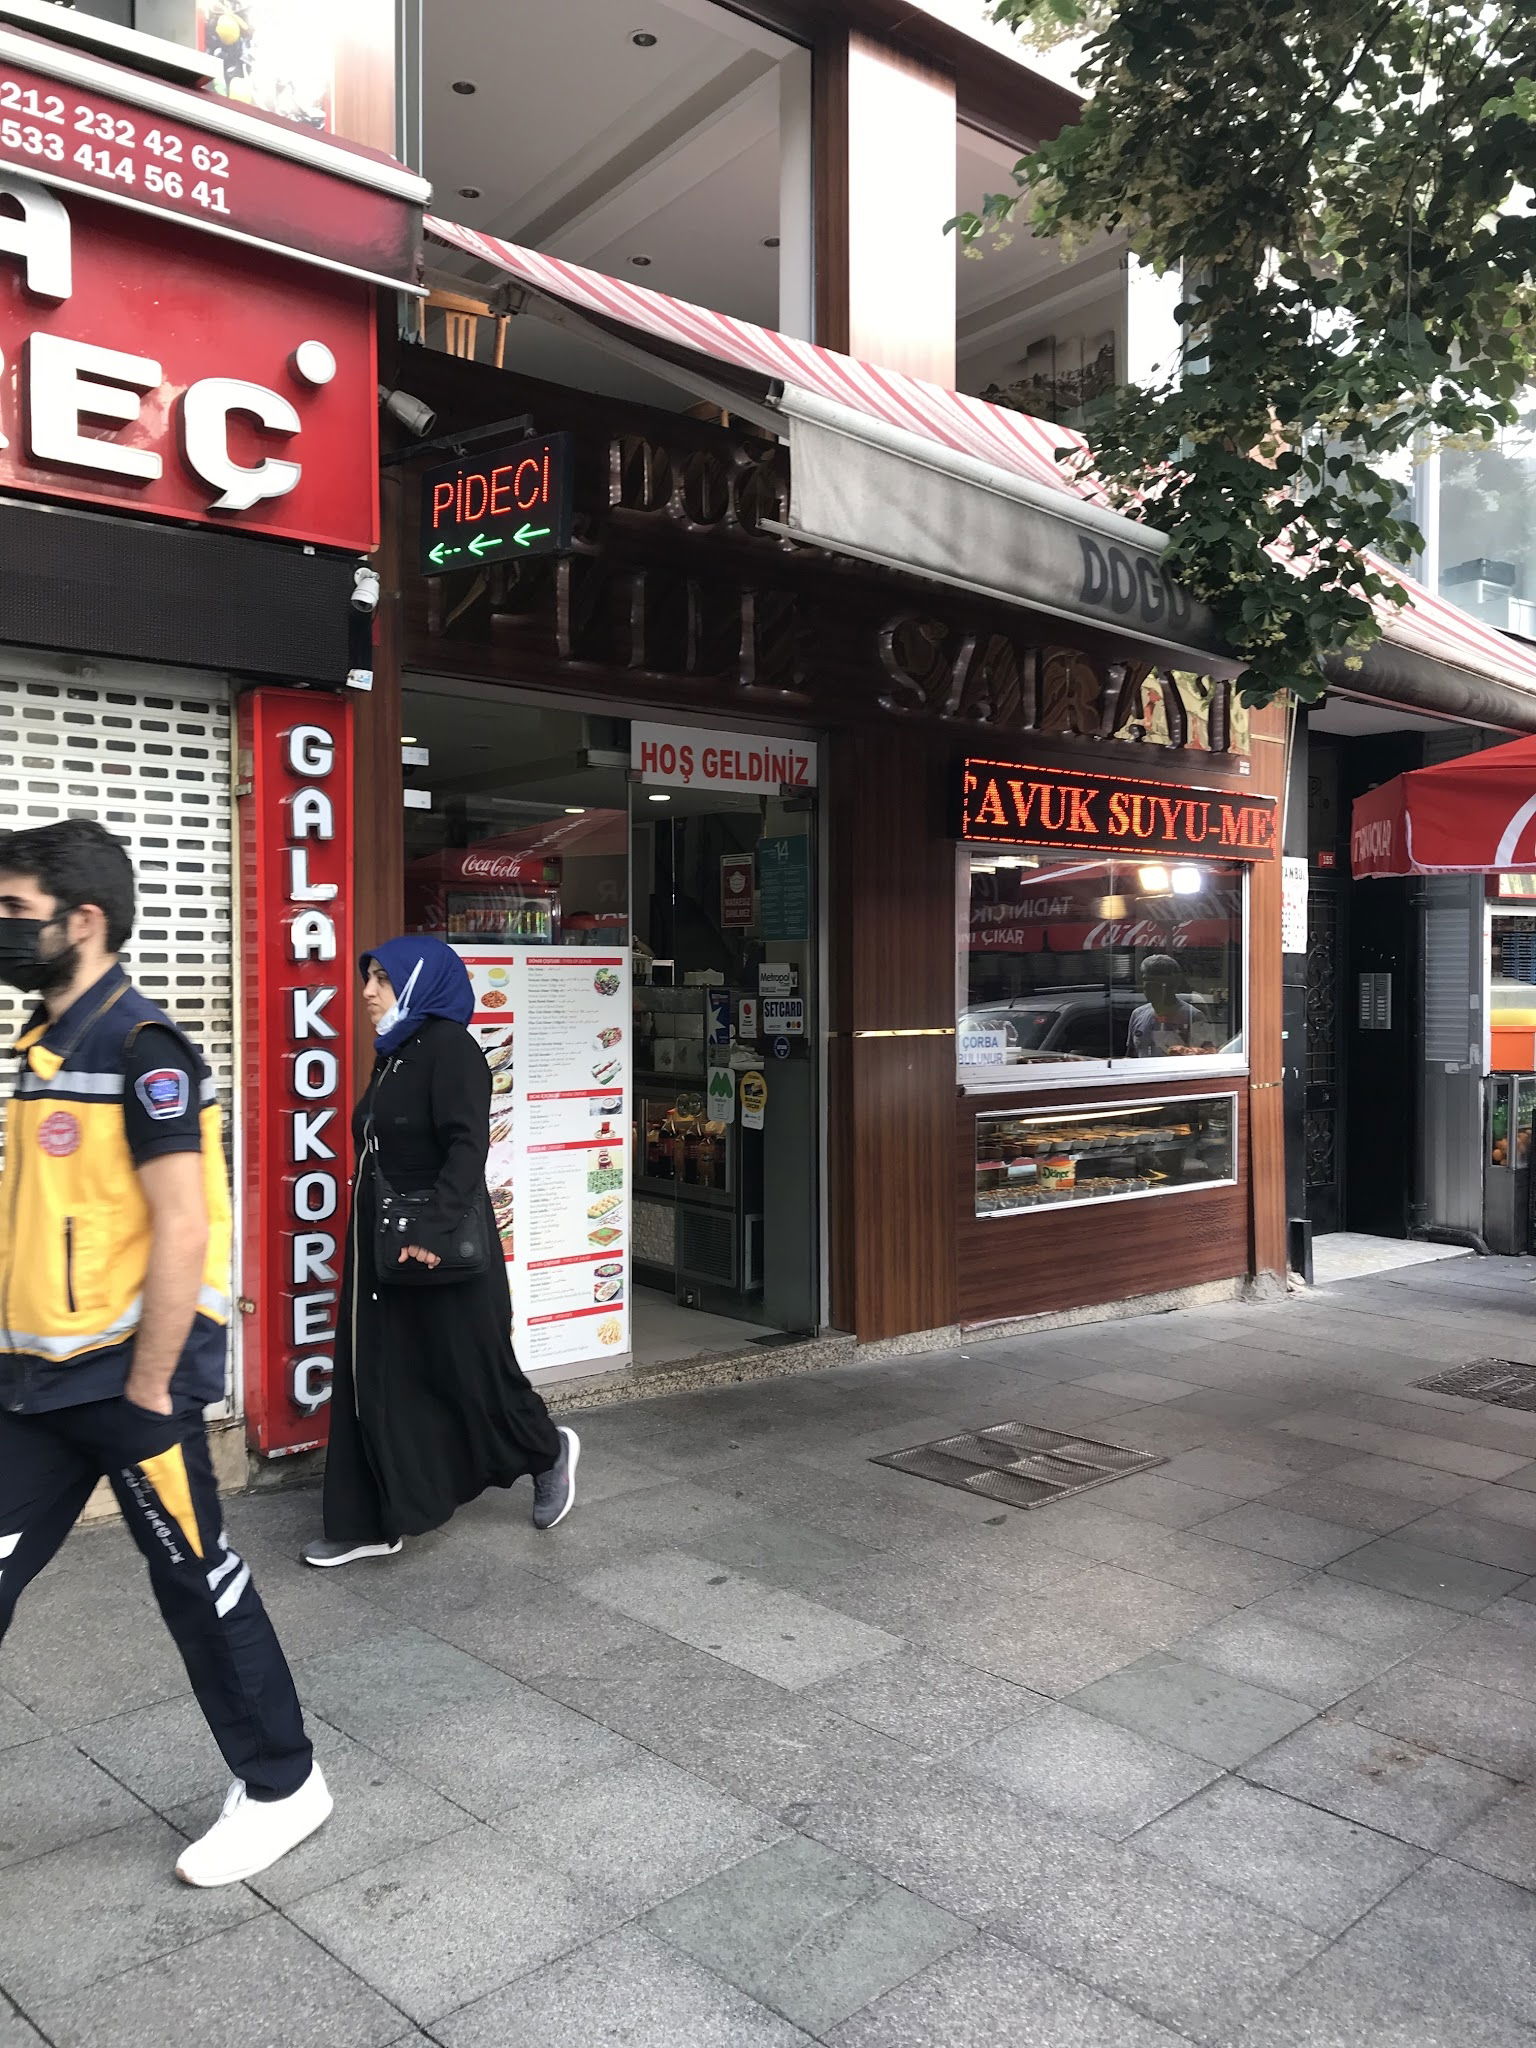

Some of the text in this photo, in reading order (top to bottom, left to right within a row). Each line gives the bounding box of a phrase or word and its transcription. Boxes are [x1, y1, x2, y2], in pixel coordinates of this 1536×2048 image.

[73, 105, 136, 148] 232
[143, 129, 183, 163] 42
[191, 144, 230, 178] 62
[73, 143, 136, 184] 414
[144, 164, 184, 198] 56
[191, 181, 231, 214] 41
[0, 331, 302, 510] EÇ
[432, 445, 550, 528] PİDECİ
[641, 741, 809, 785] HOŞ GELDİNİZ
[288, 724, 339, 962] GALA
[461, 853, 521, 878] Coca-Cola
[760, 972, 791, 985] Metropol
[764, 1001, 802, 1018] SETCARD
[962, 1036, 999, 1051] ÇORBA
